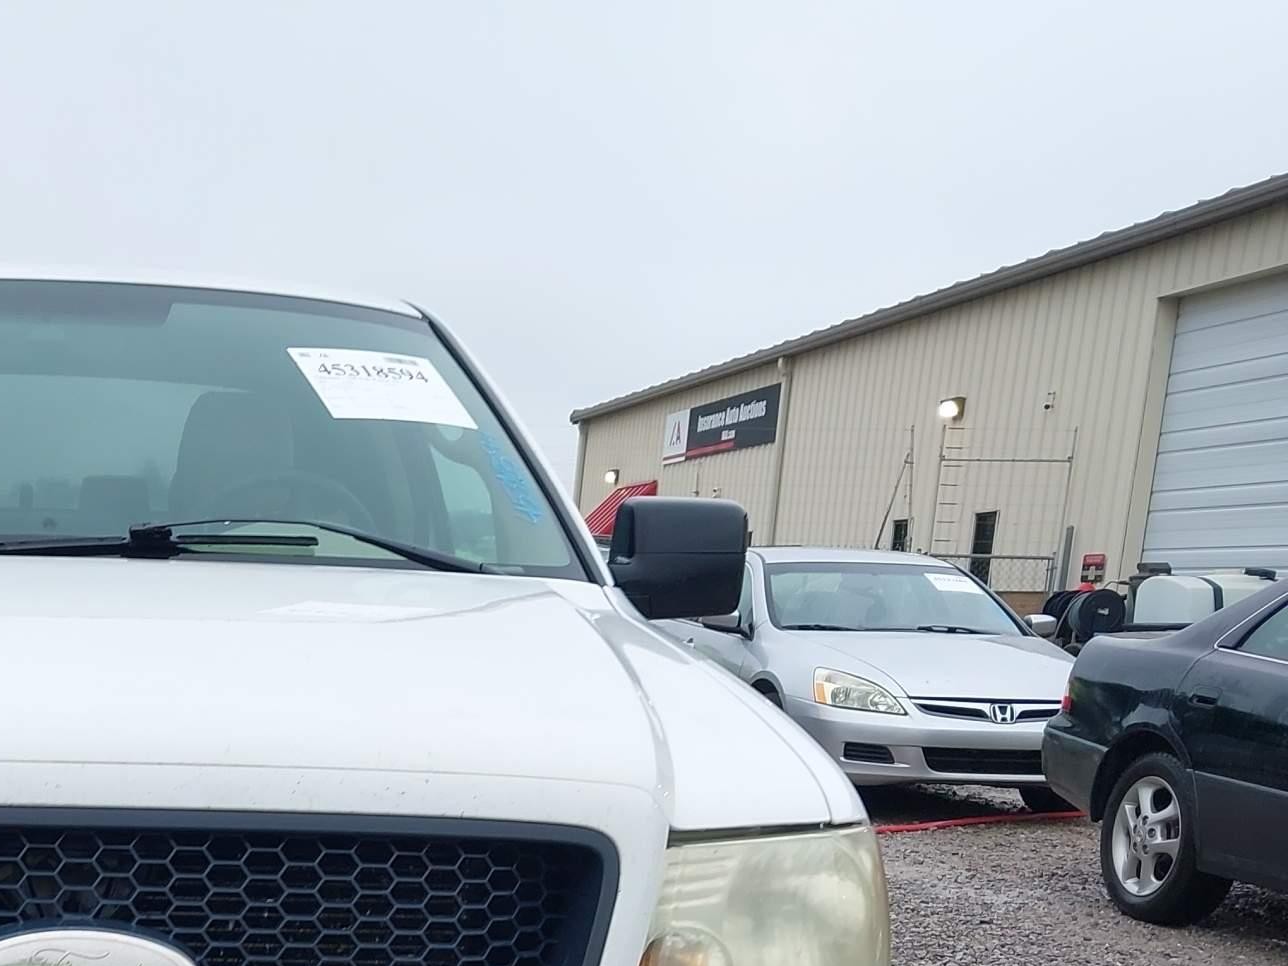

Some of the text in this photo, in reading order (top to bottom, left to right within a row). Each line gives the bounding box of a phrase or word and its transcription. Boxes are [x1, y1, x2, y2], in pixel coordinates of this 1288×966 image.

[317, 362, 429, 383] 45318594
[725, 407, 740, 425] Auto
[738, 400, 767, 422] Auctions
